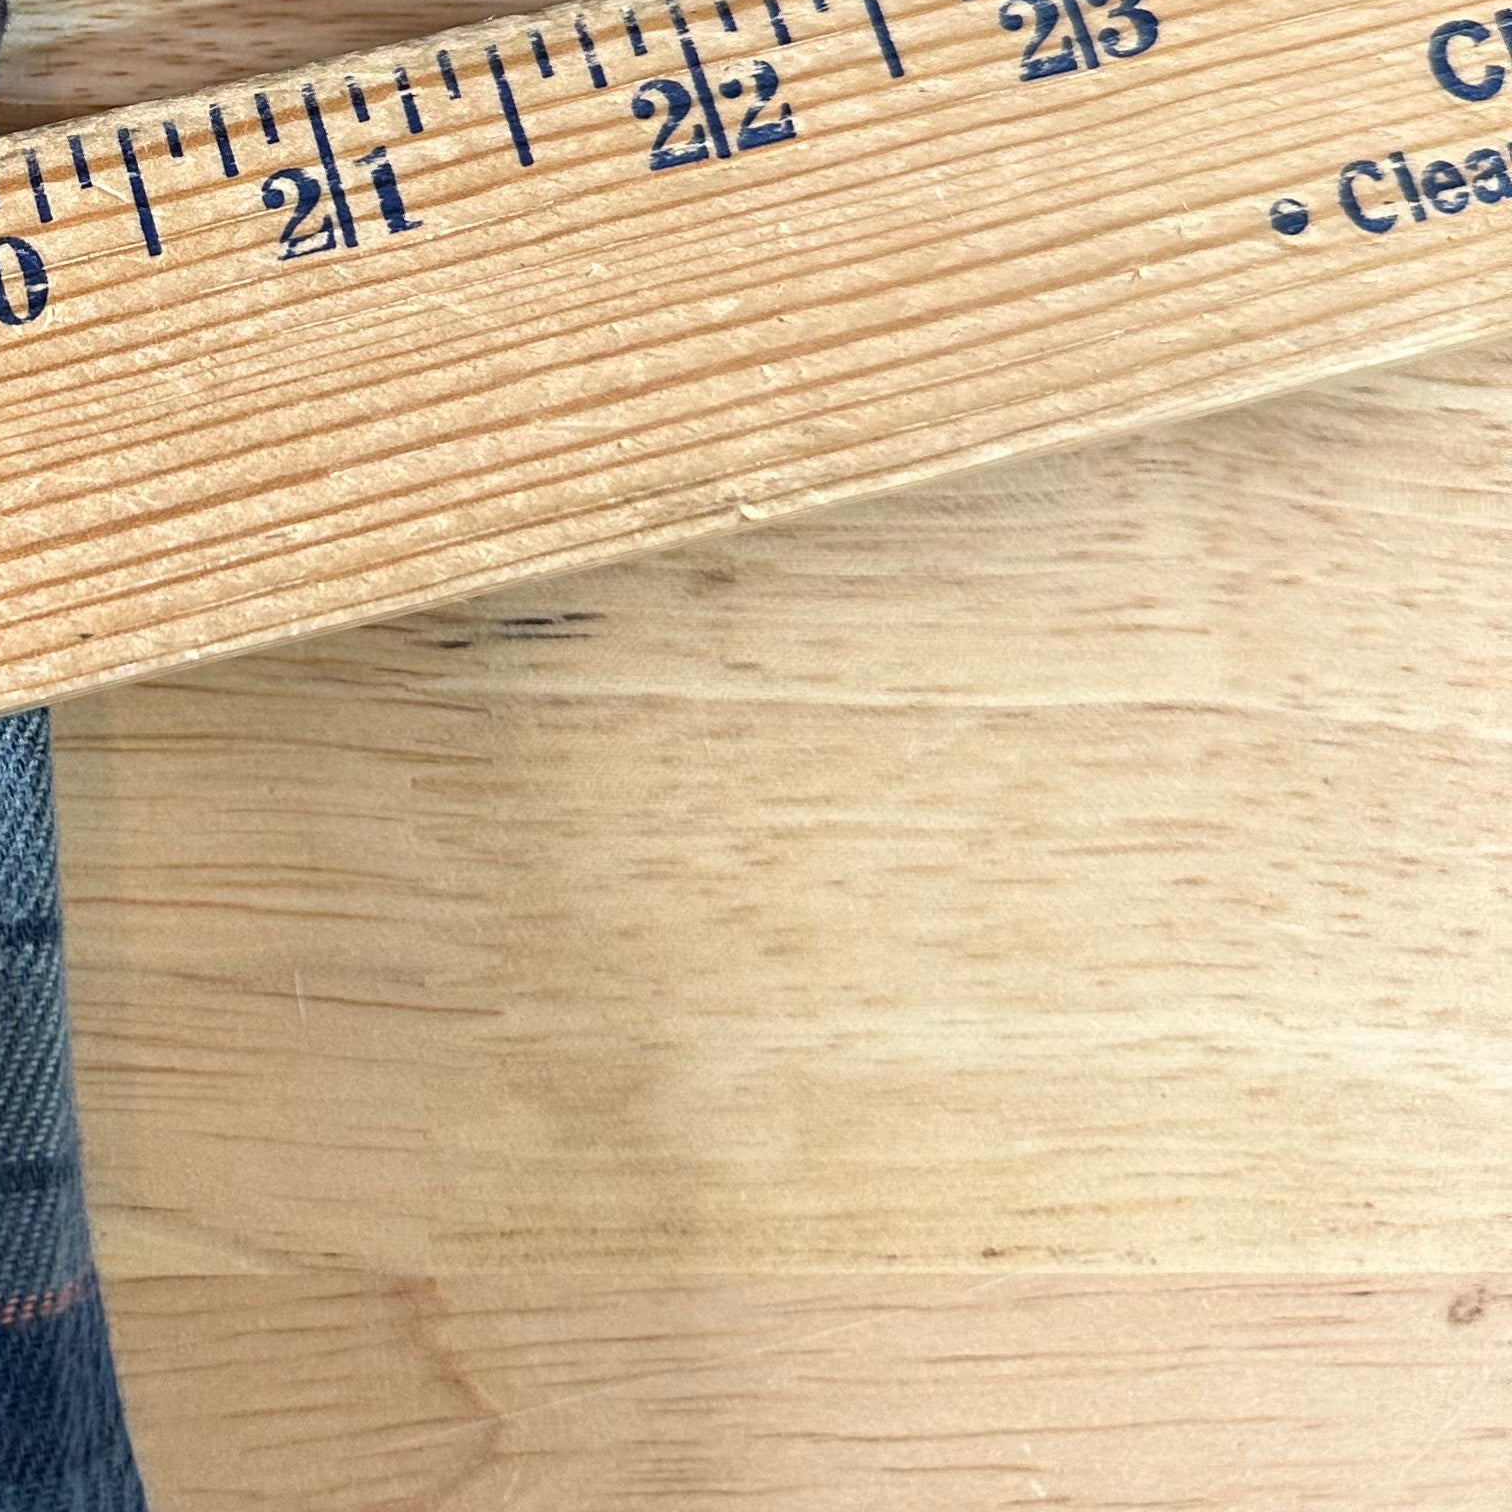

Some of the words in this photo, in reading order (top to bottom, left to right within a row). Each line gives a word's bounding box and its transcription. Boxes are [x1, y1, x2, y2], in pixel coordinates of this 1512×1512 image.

[261, 145, 423, 261] 21
[631, 60, 796, 170] 22
[1339, 142, 1512, 234] Clea
